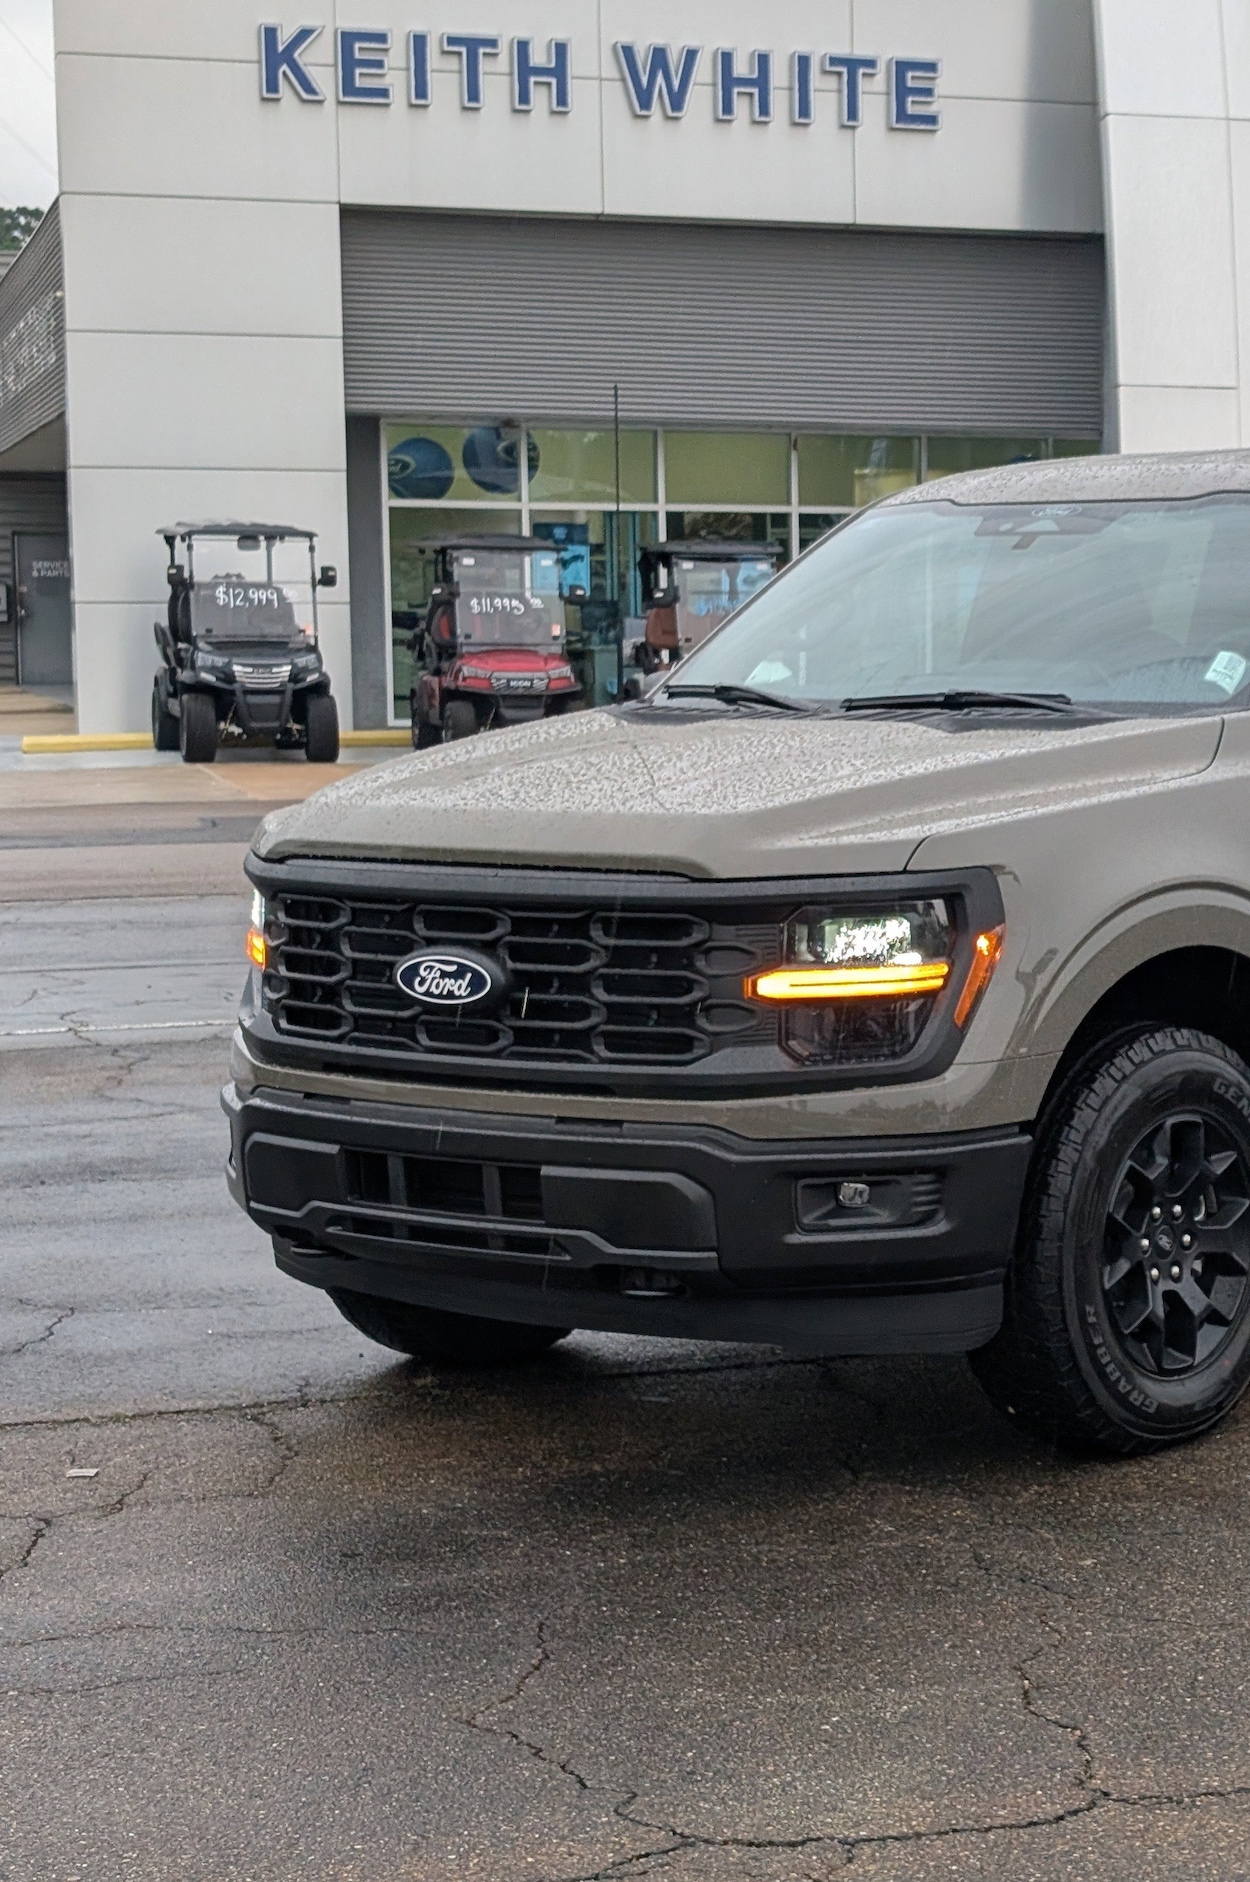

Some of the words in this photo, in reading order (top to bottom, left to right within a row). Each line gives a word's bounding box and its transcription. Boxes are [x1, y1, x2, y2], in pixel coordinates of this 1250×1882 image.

[259, 22, 573, 114] KEITH
[615, 41, 944, 132] WHITE
[215, 583, 279, 609] $12,999
[470, 597, 525, 616] $11,995
[414, 961, 473, 996] Ford
[1085, 1304, 1159, 1414] GRABBER
